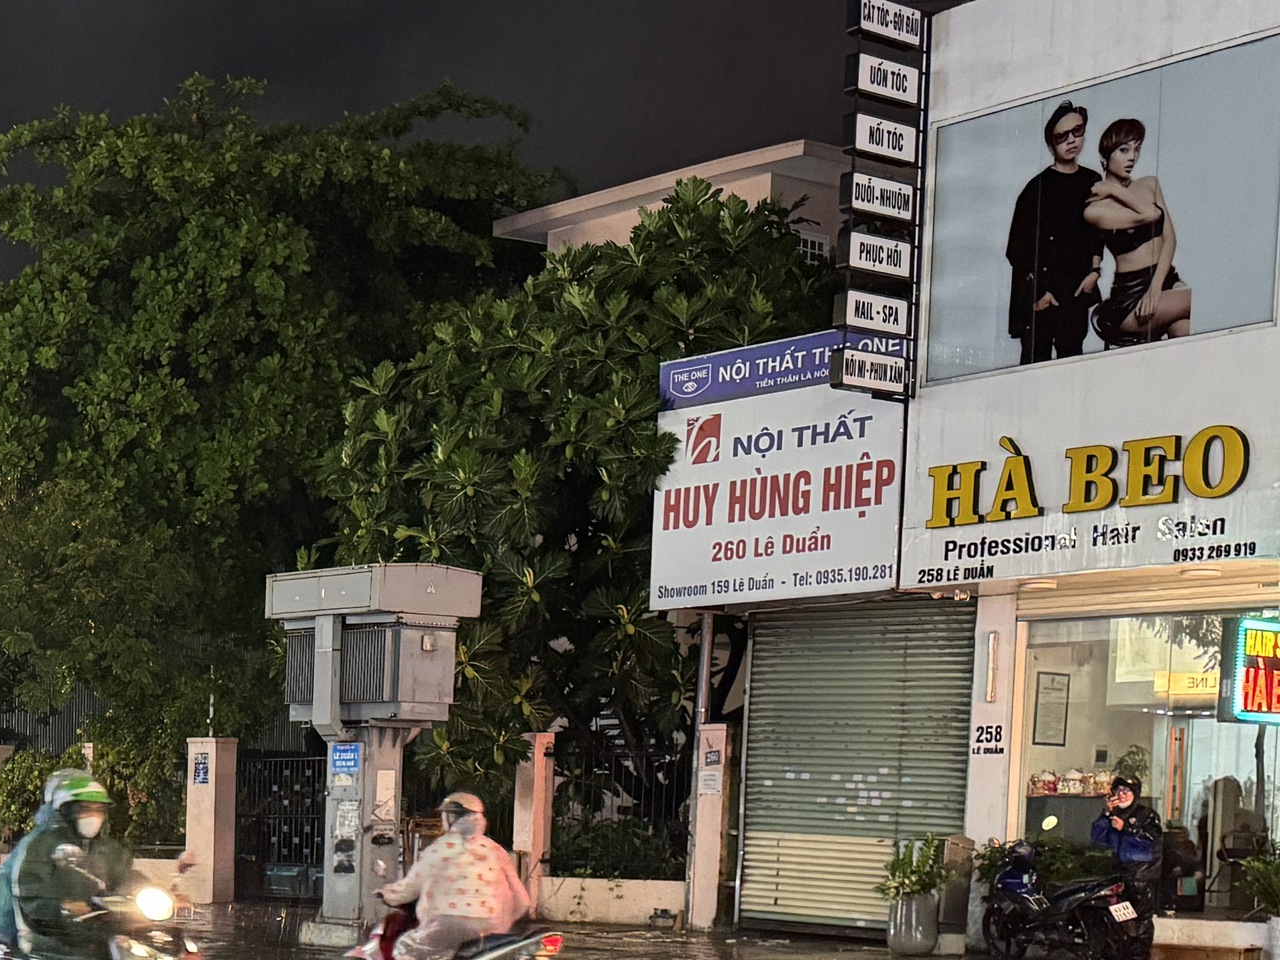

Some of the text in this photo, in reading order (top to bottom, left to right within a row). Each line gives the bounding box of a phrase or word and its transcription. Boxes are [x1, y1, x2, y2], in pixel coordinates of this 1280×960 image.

[869, 61, 908, 93] UỐN TÓC
[868, 121, 904, 152] NỐI TÓC
[859, 241, 902, 268] PHỤC HỒI
[854, 299, 874, 321] NAIL
[882, 304, 899, 326] SPA
[718, 359, 750, 383] NỘI
[755, 346, 807, 376] THẤT
[858, 337, 901, 353] ONE
[673, 369, 708, 383] THE ONE
[732, 408, 874, 459] NỘI THẤT
[662, 451, 896, 531] HUY HÙNG HIỆP
[925, 423, 1250, 529] HÀ BEO
[711, 526, 832, 563] 260 Lê Duẩn
[1092, 521, 1141, 547] Hair
[1173, 541, 1257, 563] 0933 269 919
[657, 581, 708, 599] Showroom
[710, 579, 730, 595] 159
[733, 577, 745, 593] Lê
[792, 572, 813, 588] Tel:
[815, 563, 894, 586] 0935.190.281
[917, 559, 995, 584] 258 LÊ DUẨN
[1245, 629, 1276, 658] HAIR
[1241, 656, 1268, 712] HÀ
[975, 724, 1003, 744] 258
[972, 745, 981, 755] LÊ
